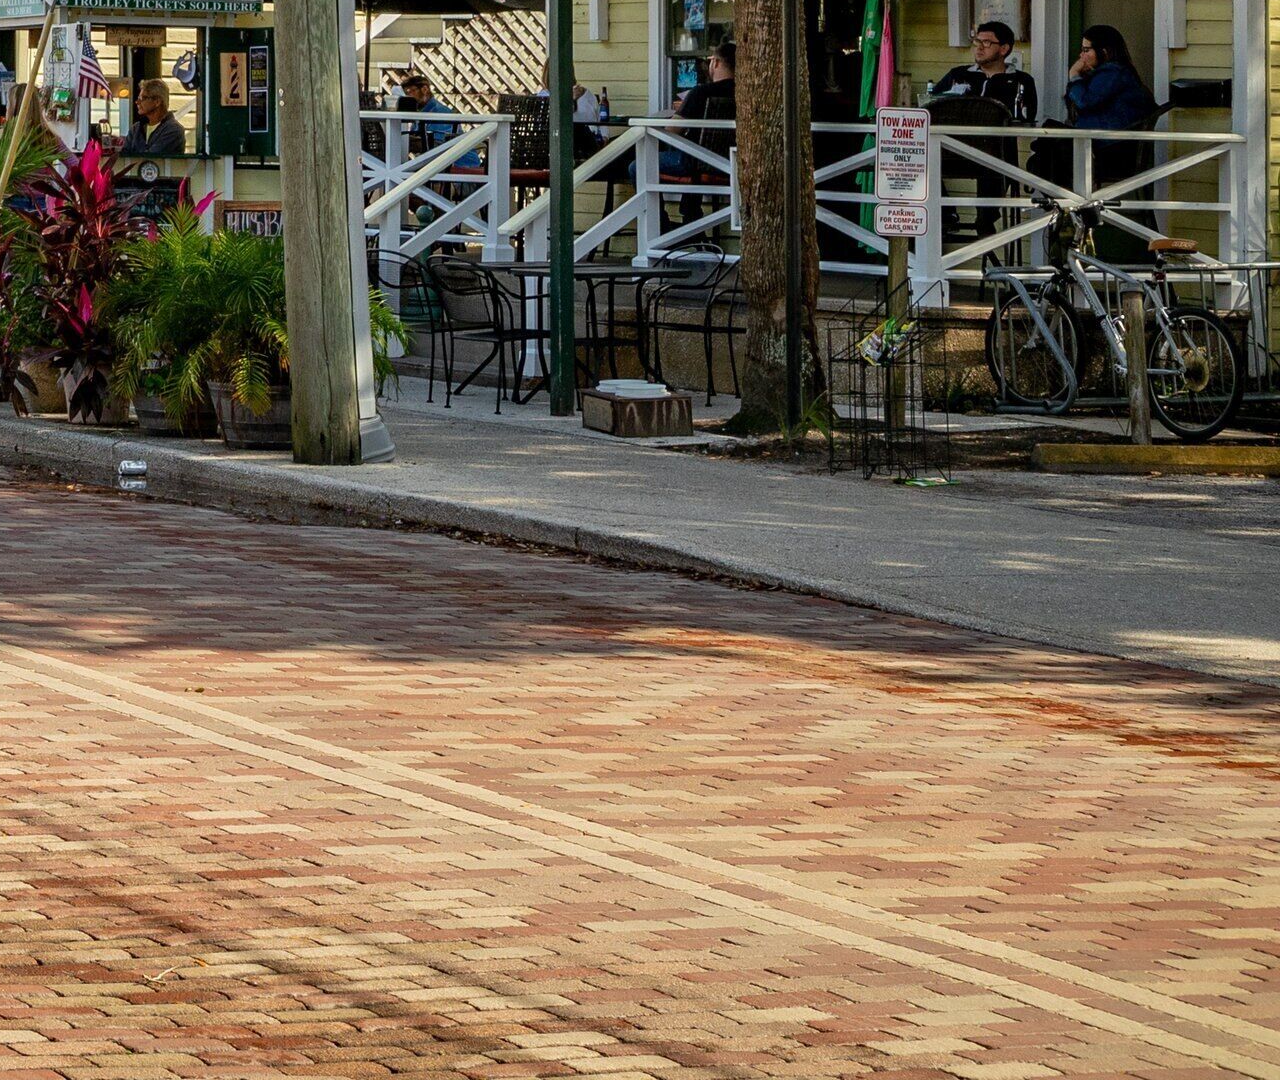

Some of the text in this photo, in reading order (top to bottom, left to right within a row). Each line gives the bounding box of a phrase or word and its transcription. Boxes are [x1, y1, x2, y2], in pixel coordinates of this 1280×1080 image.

[189, 0, 222, 11] SOLD
[224, 2, 257, 12] HERE
[881, 116, 926, 129] TOW AWAY
[892, 128, 914, 139] ZONE
[880, 146, 925, 155] BURGER BUCKETS
[893, 154, 912, 162] ONLY
[884, 223, 901, 231] CARS
